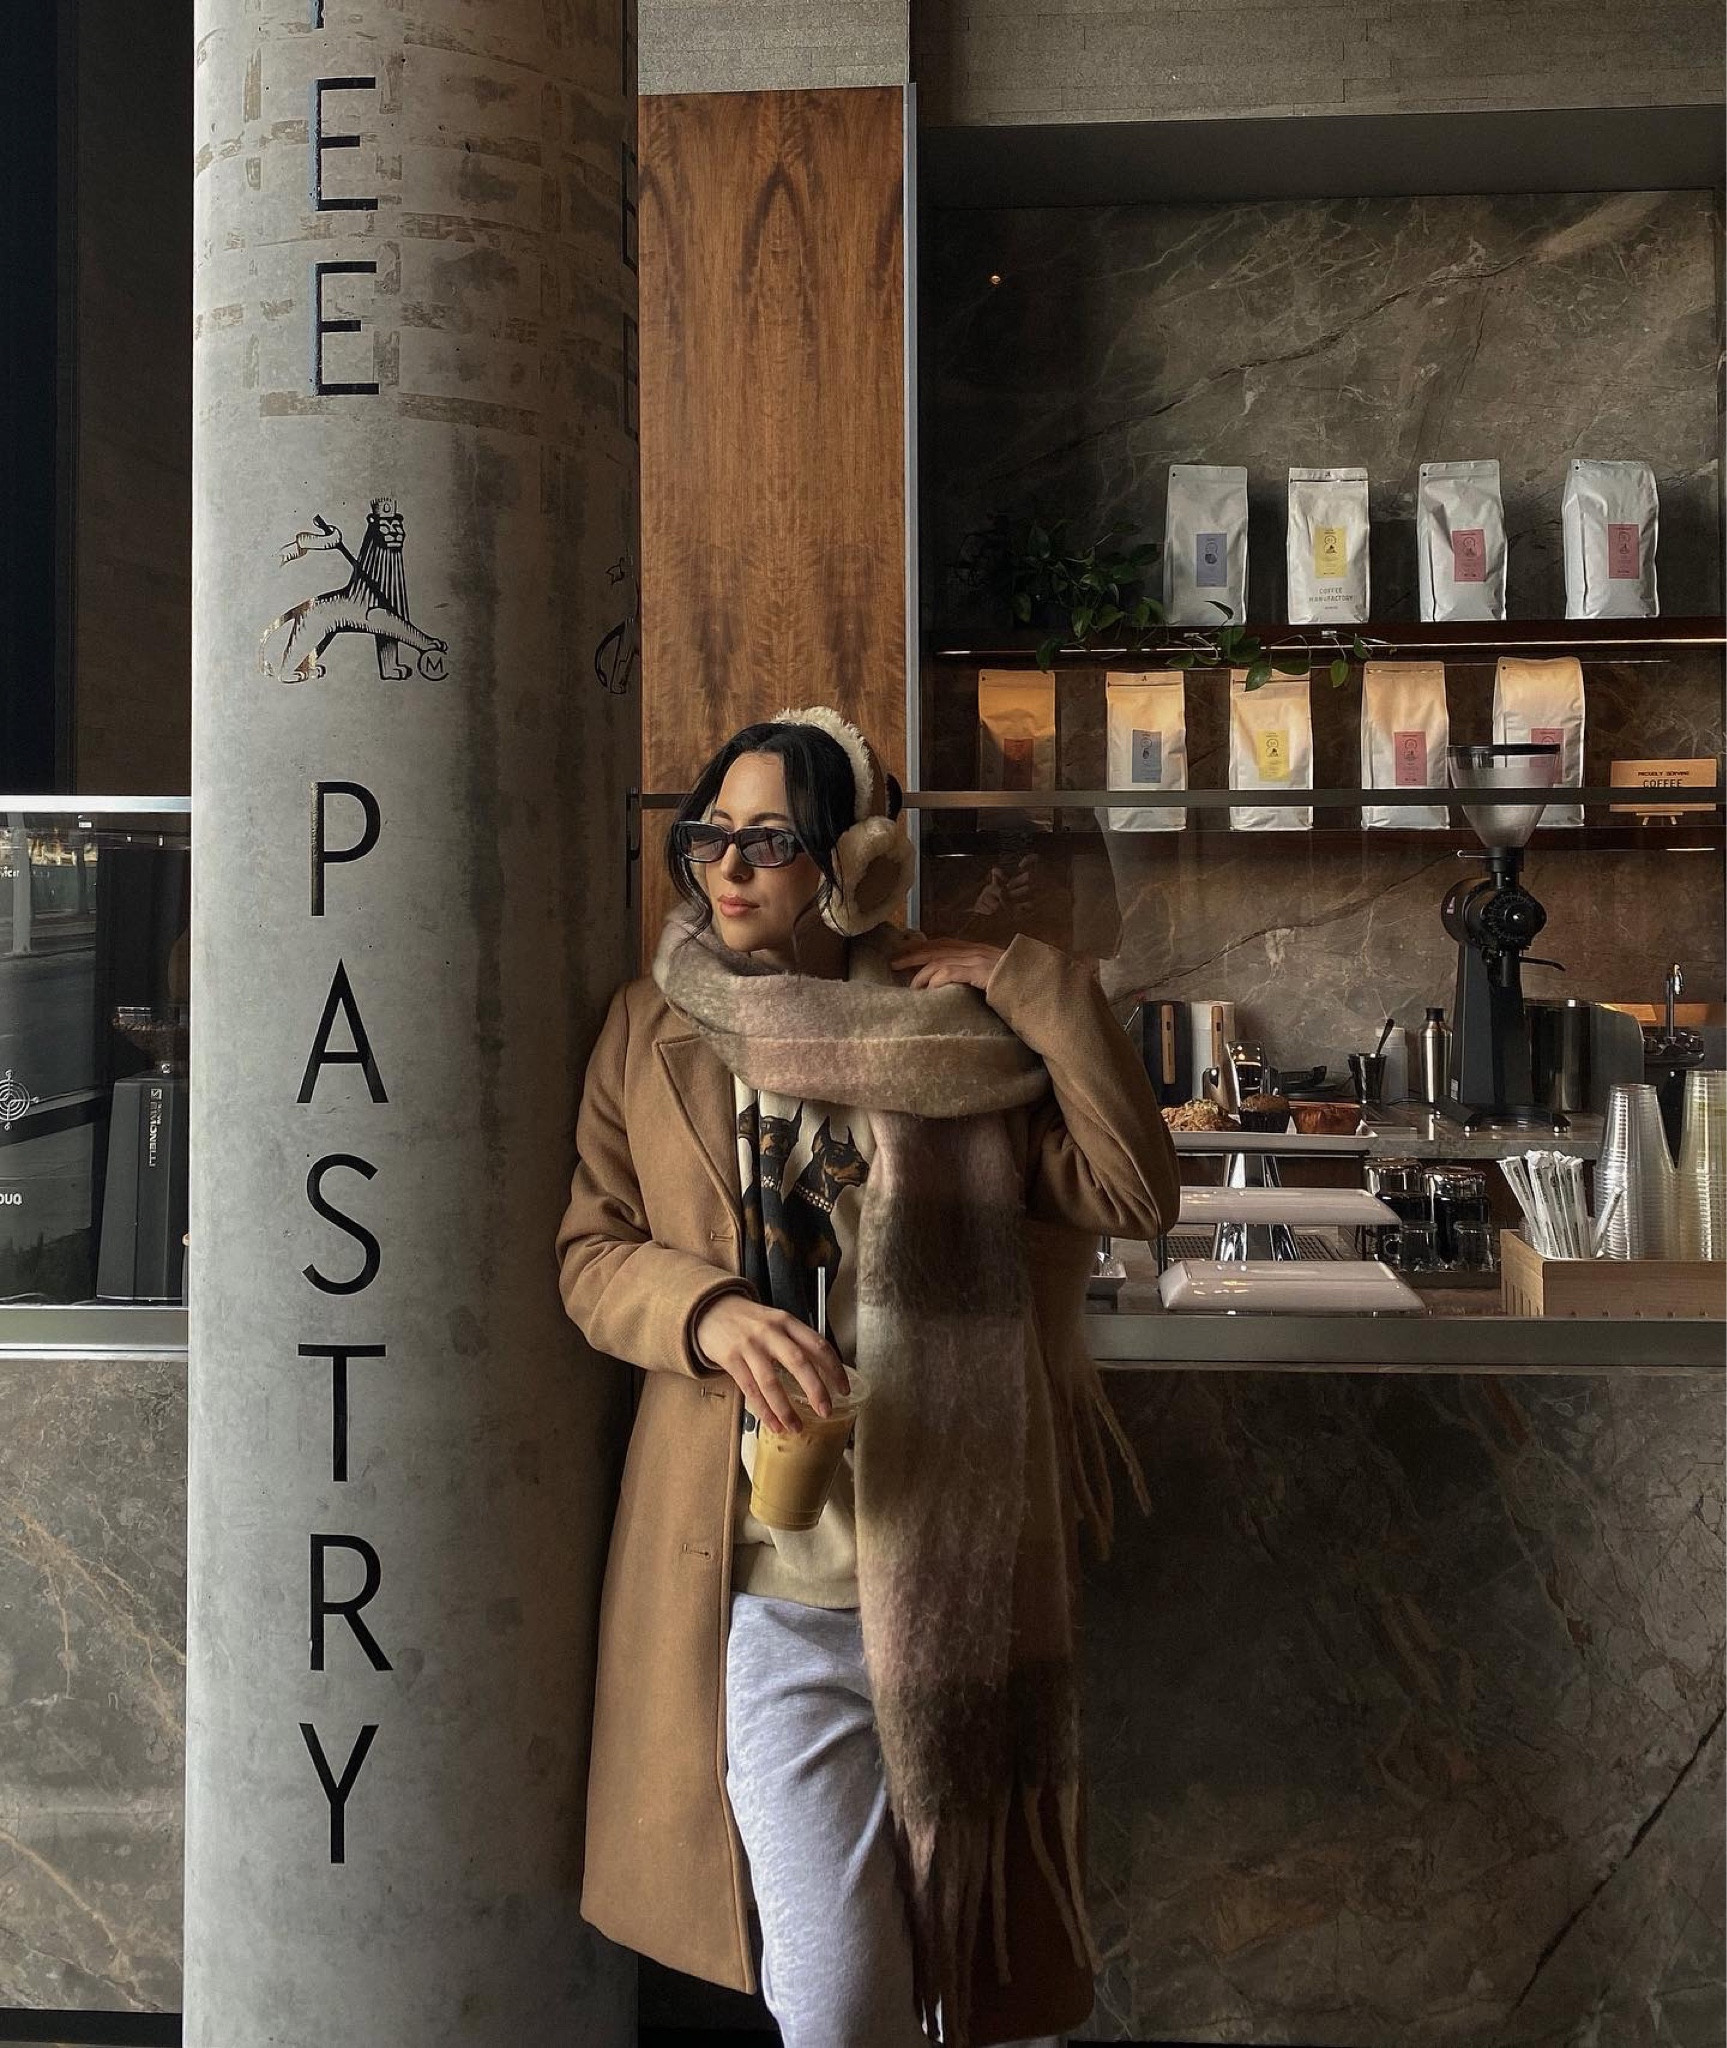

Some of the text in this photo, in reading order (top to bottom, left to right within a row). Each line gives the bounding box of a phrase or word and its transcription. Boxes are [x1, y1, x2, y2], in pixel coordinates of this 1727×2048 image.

[312, 0, 379, 395] EE
[1319, 587, 1343, 595] COFFEE
[1643, 778, 1683, 788] COFFEE
[296, 781, 393, 1864] PASTRY
